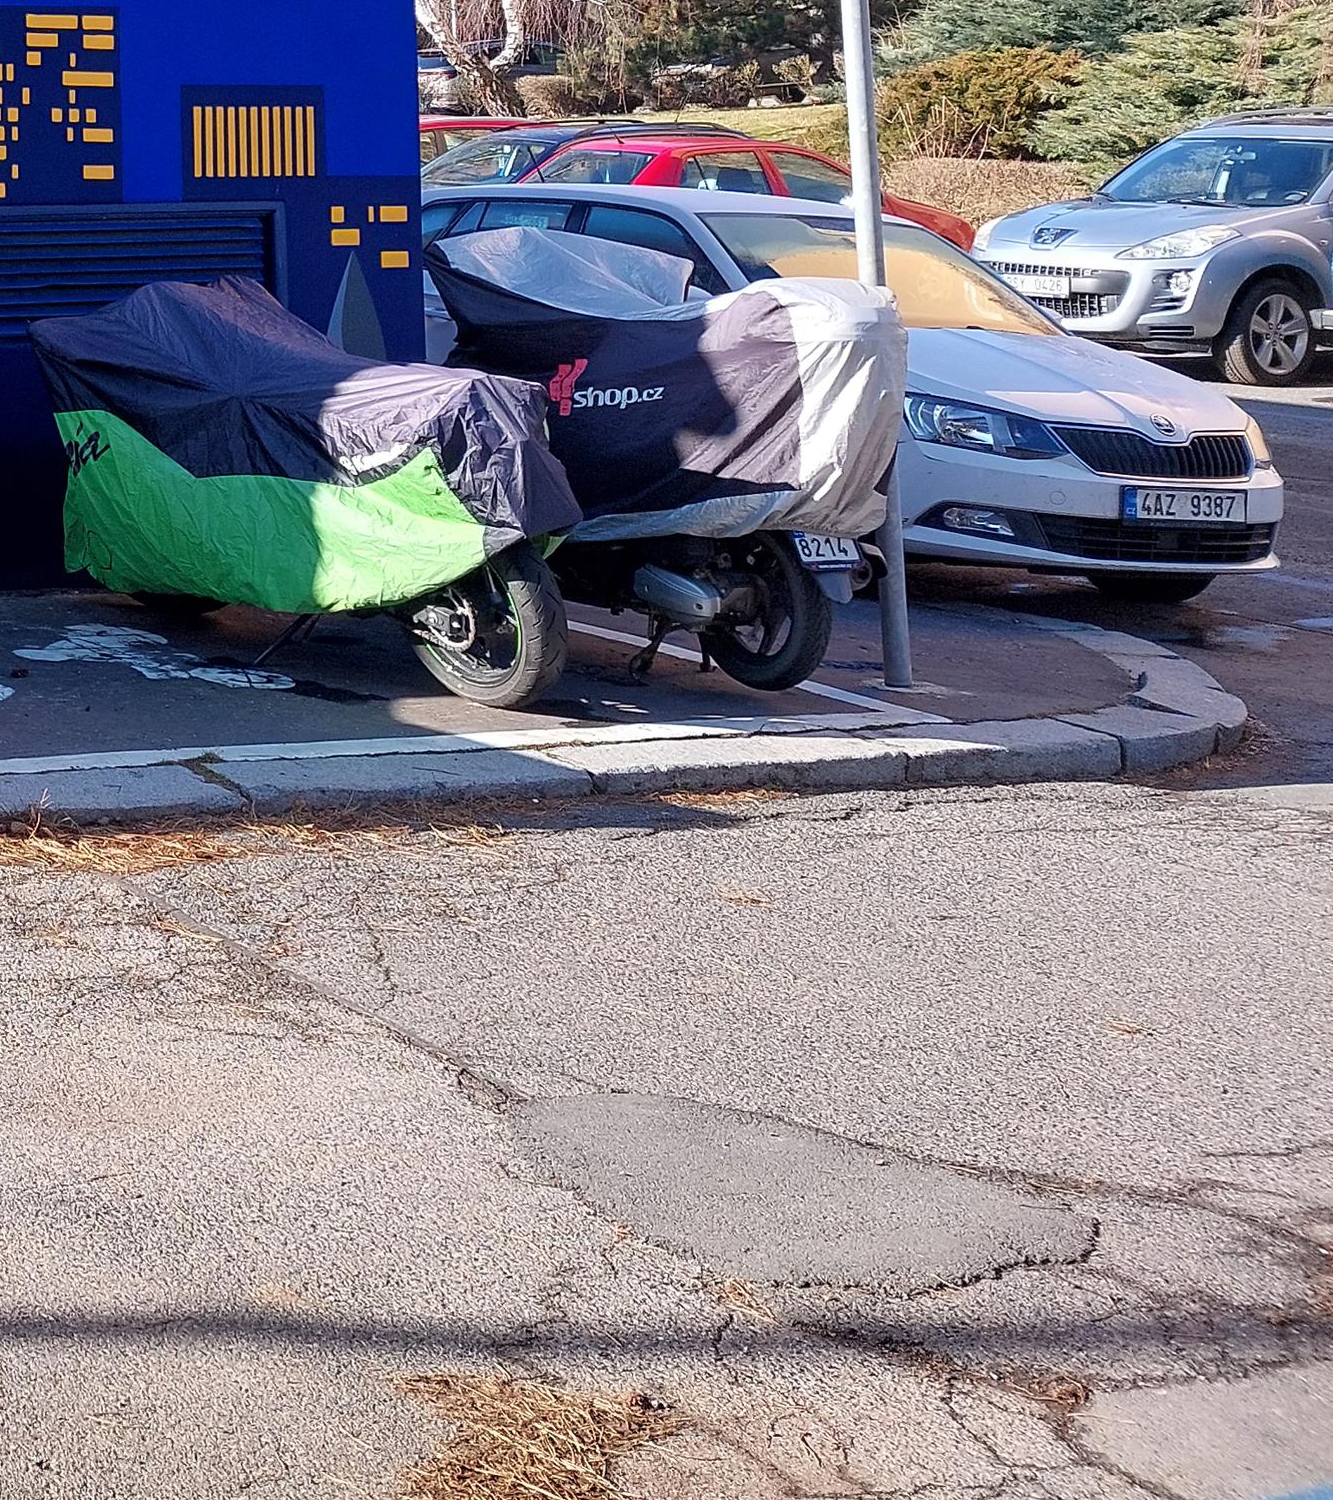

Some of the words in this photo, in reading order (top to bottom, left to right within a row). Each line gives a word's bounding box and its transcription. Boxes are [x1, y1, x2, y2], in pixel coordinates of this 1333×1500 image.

[573, 386, 665, 409] shop.cz
[1141, 493, 1177, 516] 4AZ
[1191, 494, 1236, 518] 9387
[799, 538, 849, 558] 8214
